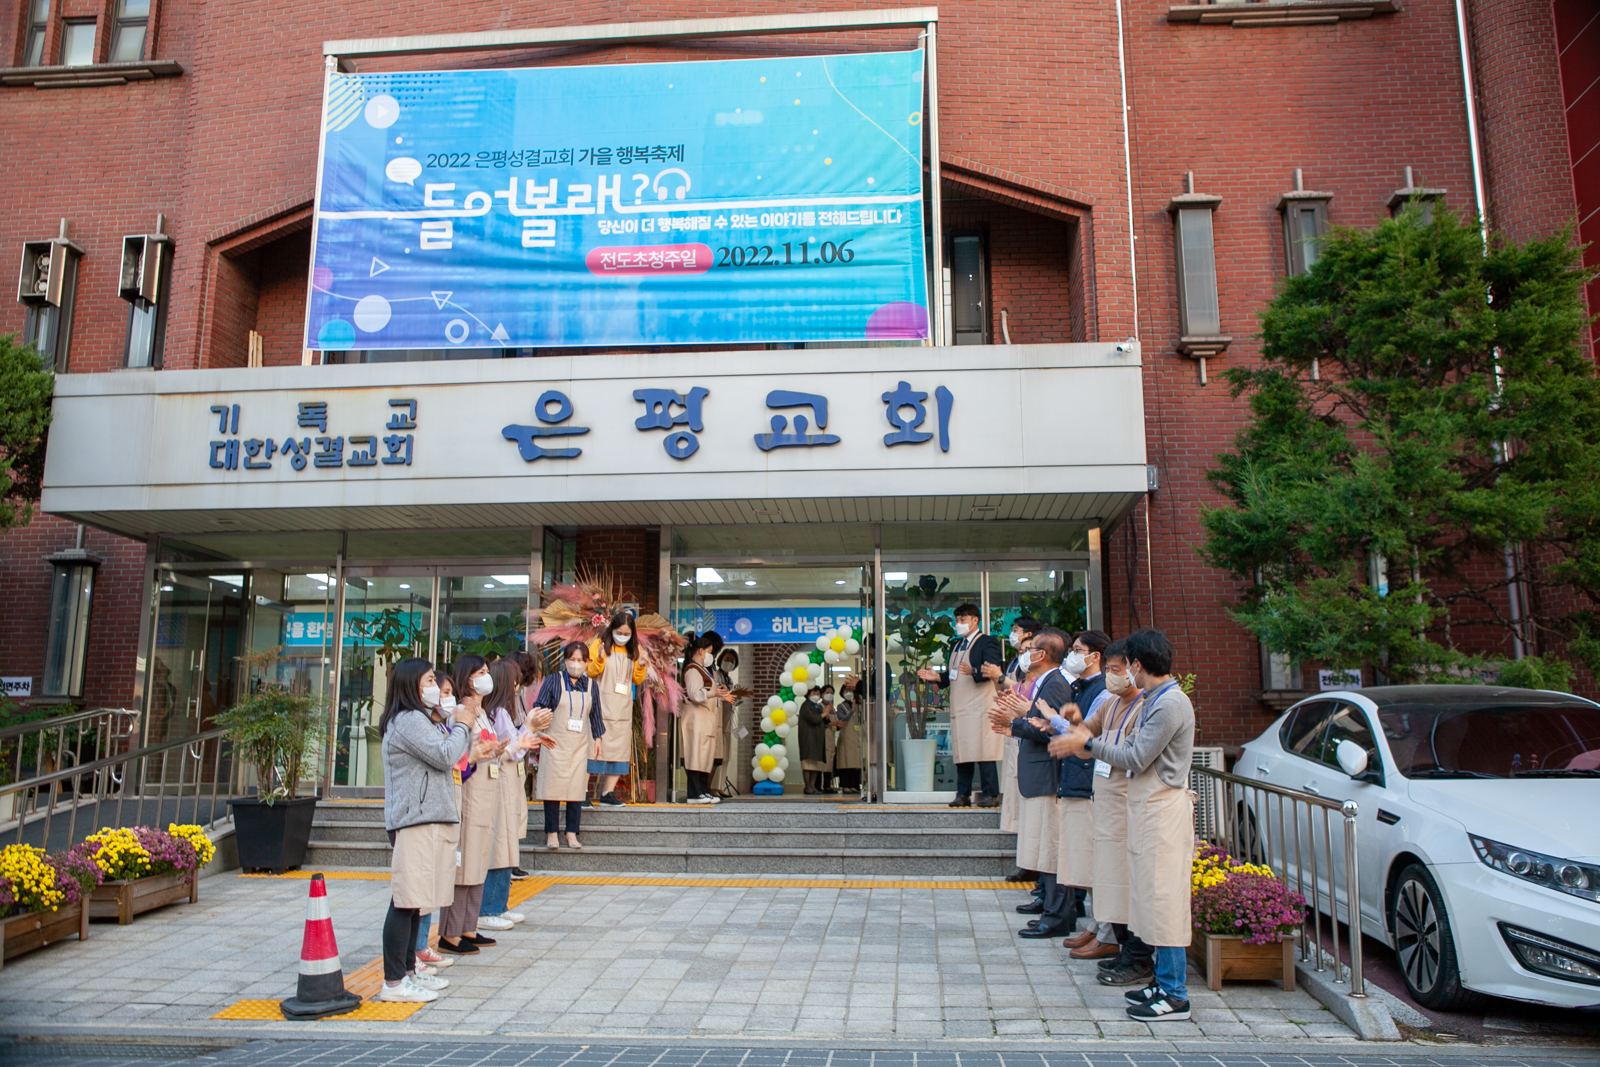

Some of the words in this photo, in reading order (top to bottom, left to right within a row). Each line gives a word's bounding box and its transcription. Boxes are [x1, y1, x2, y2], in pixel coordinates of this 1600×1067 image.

[426, 153, 471, 169] 2022
[474, 148, 575, 169] 은평성결교회
[579, 147, 614, 167] 가을
[616, 144, 685, 165] 행복축제
[598, 218, 639, 235] 당신이
[641, 218, 655, 233] 더
[657, 215, 712, 232] 행복해질
[713, 214, 728, 229] 수
[730, 213, 759, 229] 있는
[760, 211, 816, 227] 이야기를
[818, 208, 903, 226] 전해드립니다
[600, 249, 697, 271] 전도초청주일
[717, 238, 855, 268] 2022.11.06
[501, 381, 955, 462] 은평교회
[209, 434, 414, 471] 대한성결교회
[772, 616, 834, 634] 하나님은
